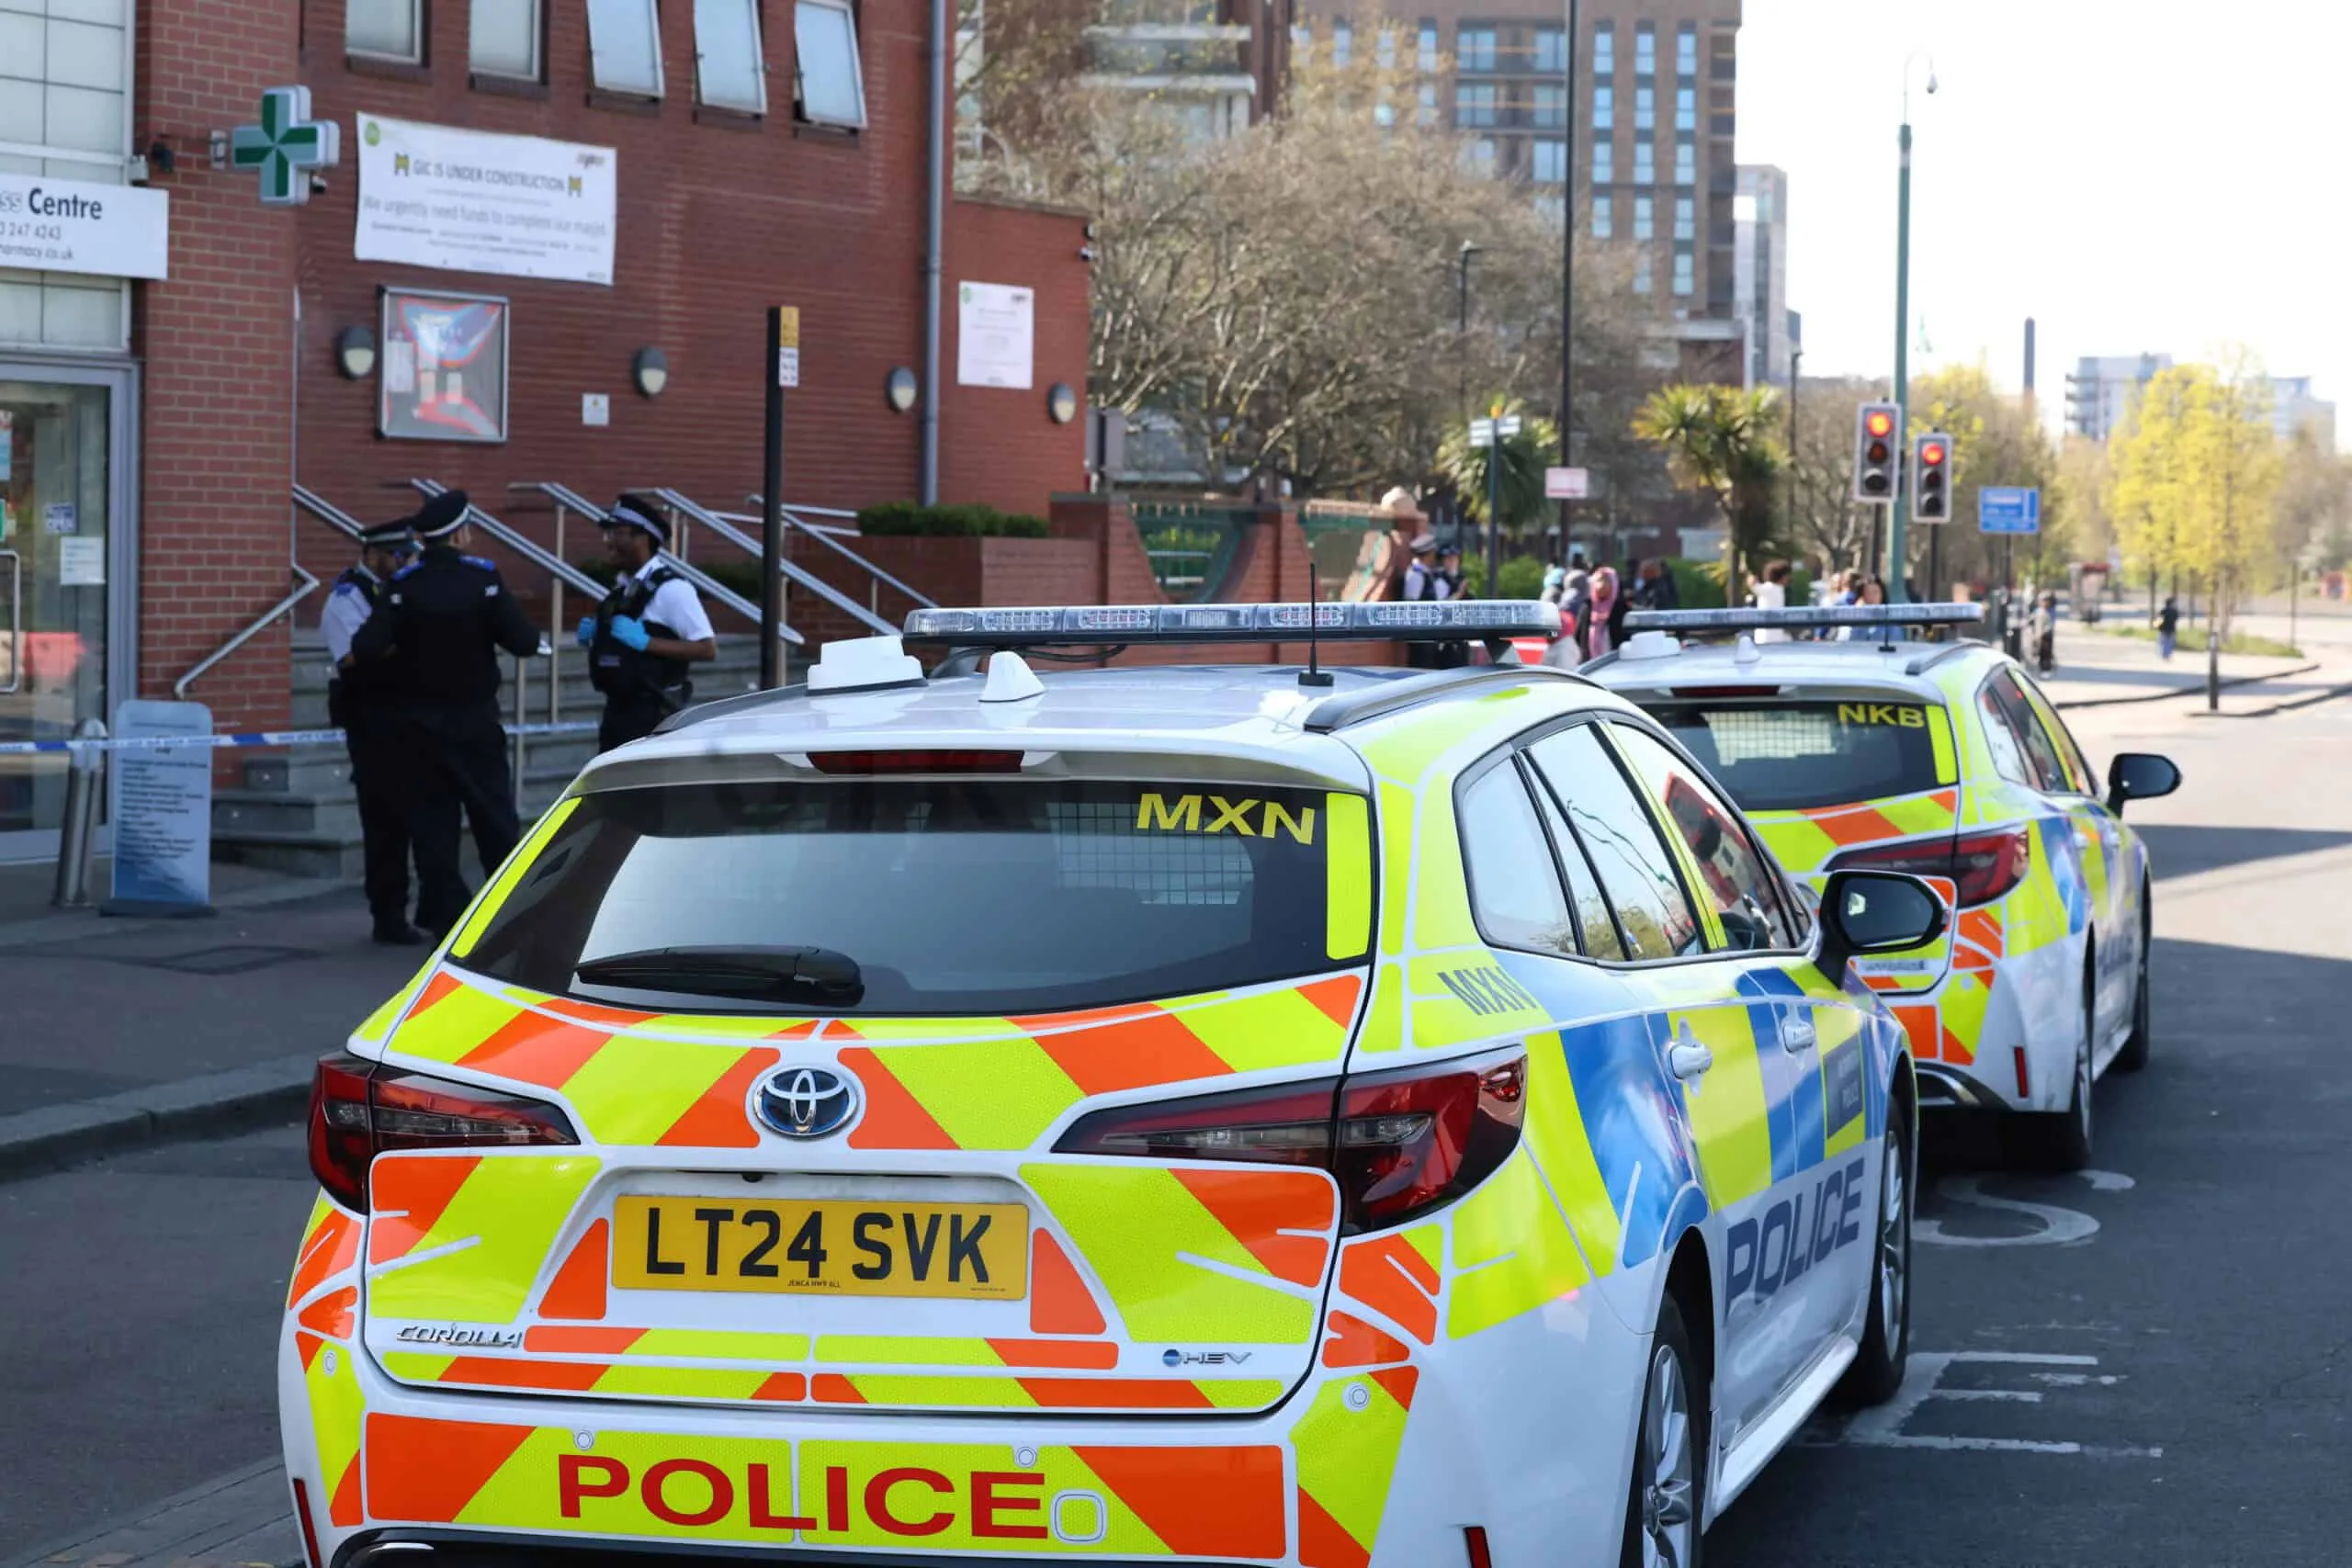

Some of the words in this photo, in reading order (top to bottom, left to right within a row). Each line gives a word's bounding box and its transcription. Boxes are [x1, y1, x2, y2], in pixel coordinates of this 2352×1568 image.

[446, 164, 482, 183] UNDER
[484, 169, 565, 192] CONSTRUCTION
[28, 186, 103, 220] Centre
[1838, 704, 1925, 728] NKB
[1136, 794, 1315, 845] MXN
[1437, 966, 1537, 1015] MXN
[646, 1207, 827, 1279] LT24
[852, 1212, 992, 1283] SVK
[1722, 1157, 1864, 1328] POLICE
[396, 1325, 523, 1348] COROLLA
[1183, 1351, 1252, 1365] HEV
[558, 1453, 1049, 1540] POLICE
